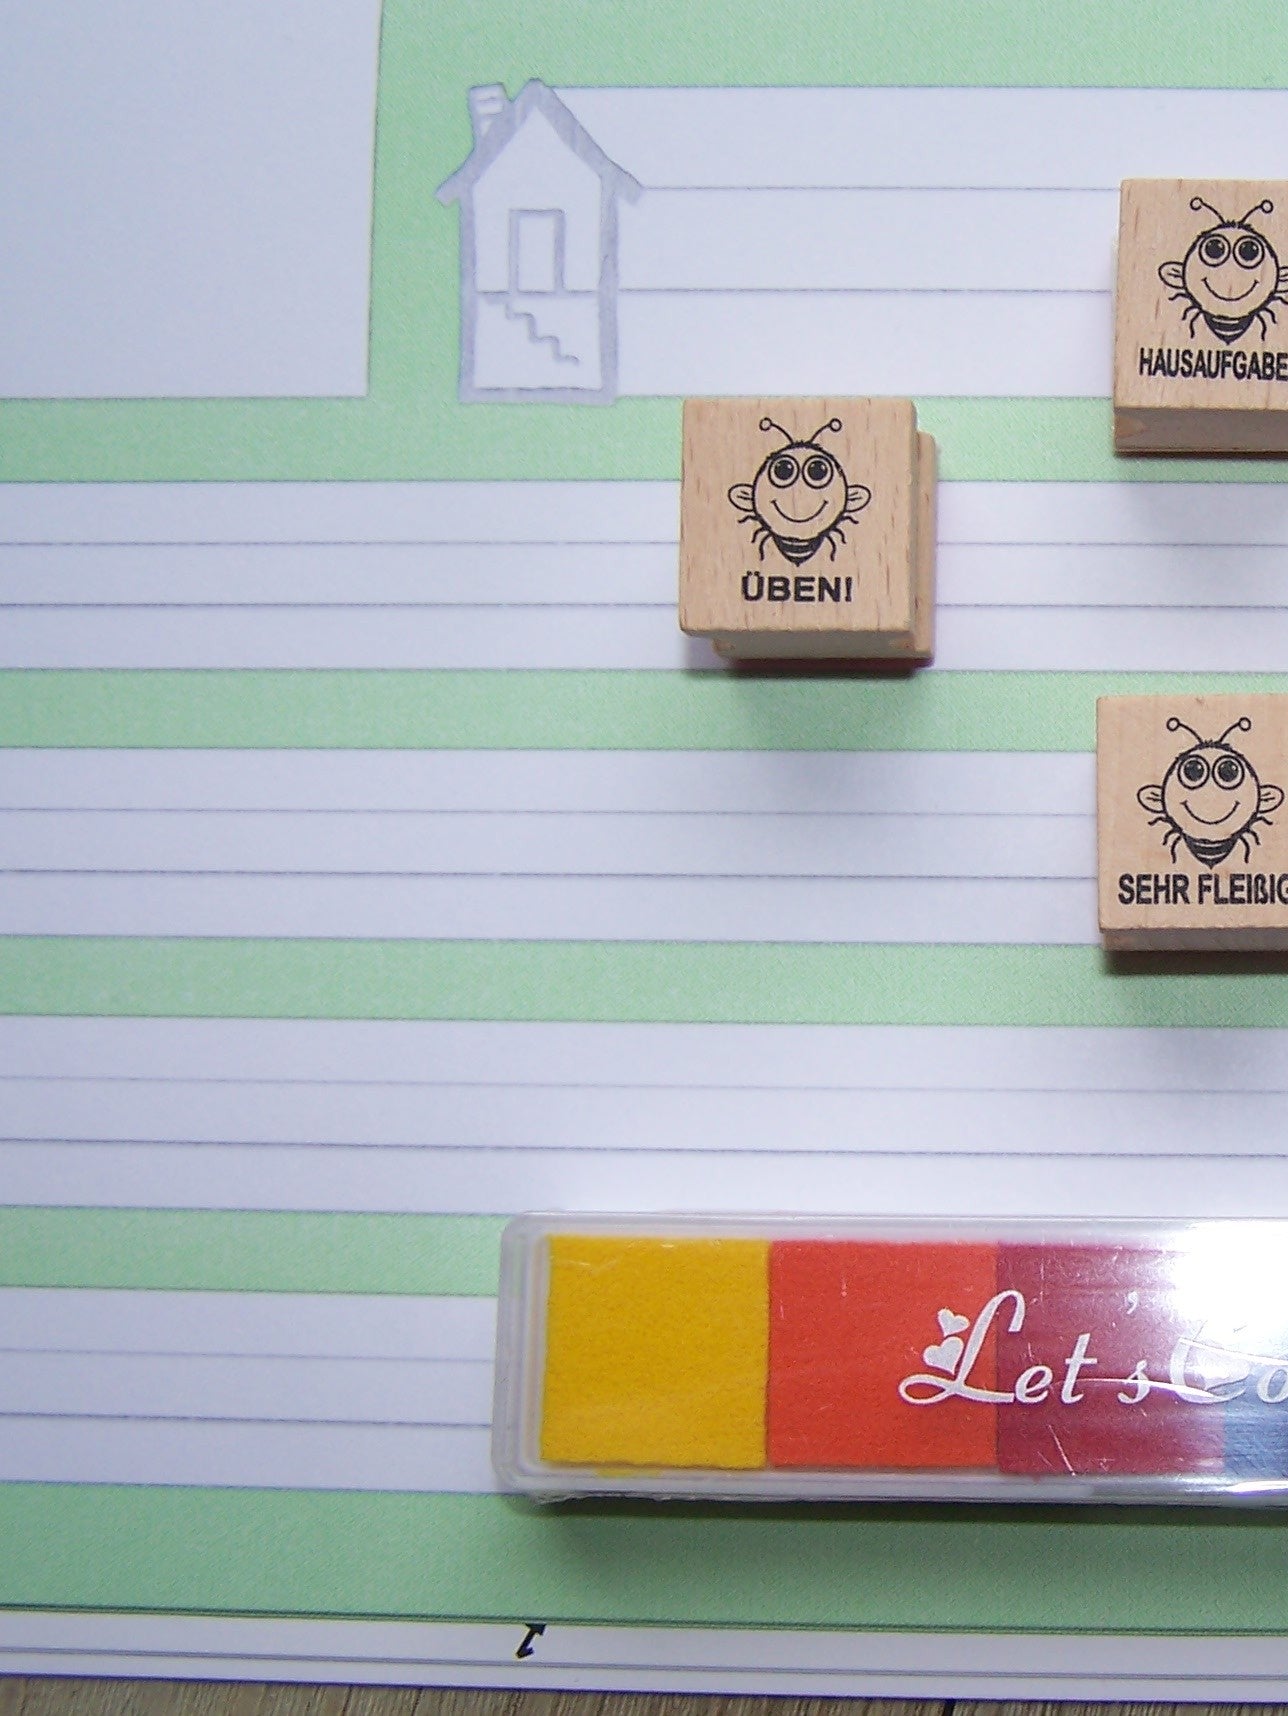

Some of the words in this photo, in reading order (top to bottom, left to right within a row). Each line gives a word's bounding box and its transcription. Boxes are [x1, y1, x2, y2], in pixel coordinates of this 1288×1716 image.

[741, 571, 852, 602] ÜBEN!
[1118, 873, 1190, 905] SEHR
[899, 1289, 1152, 1404] Let's
